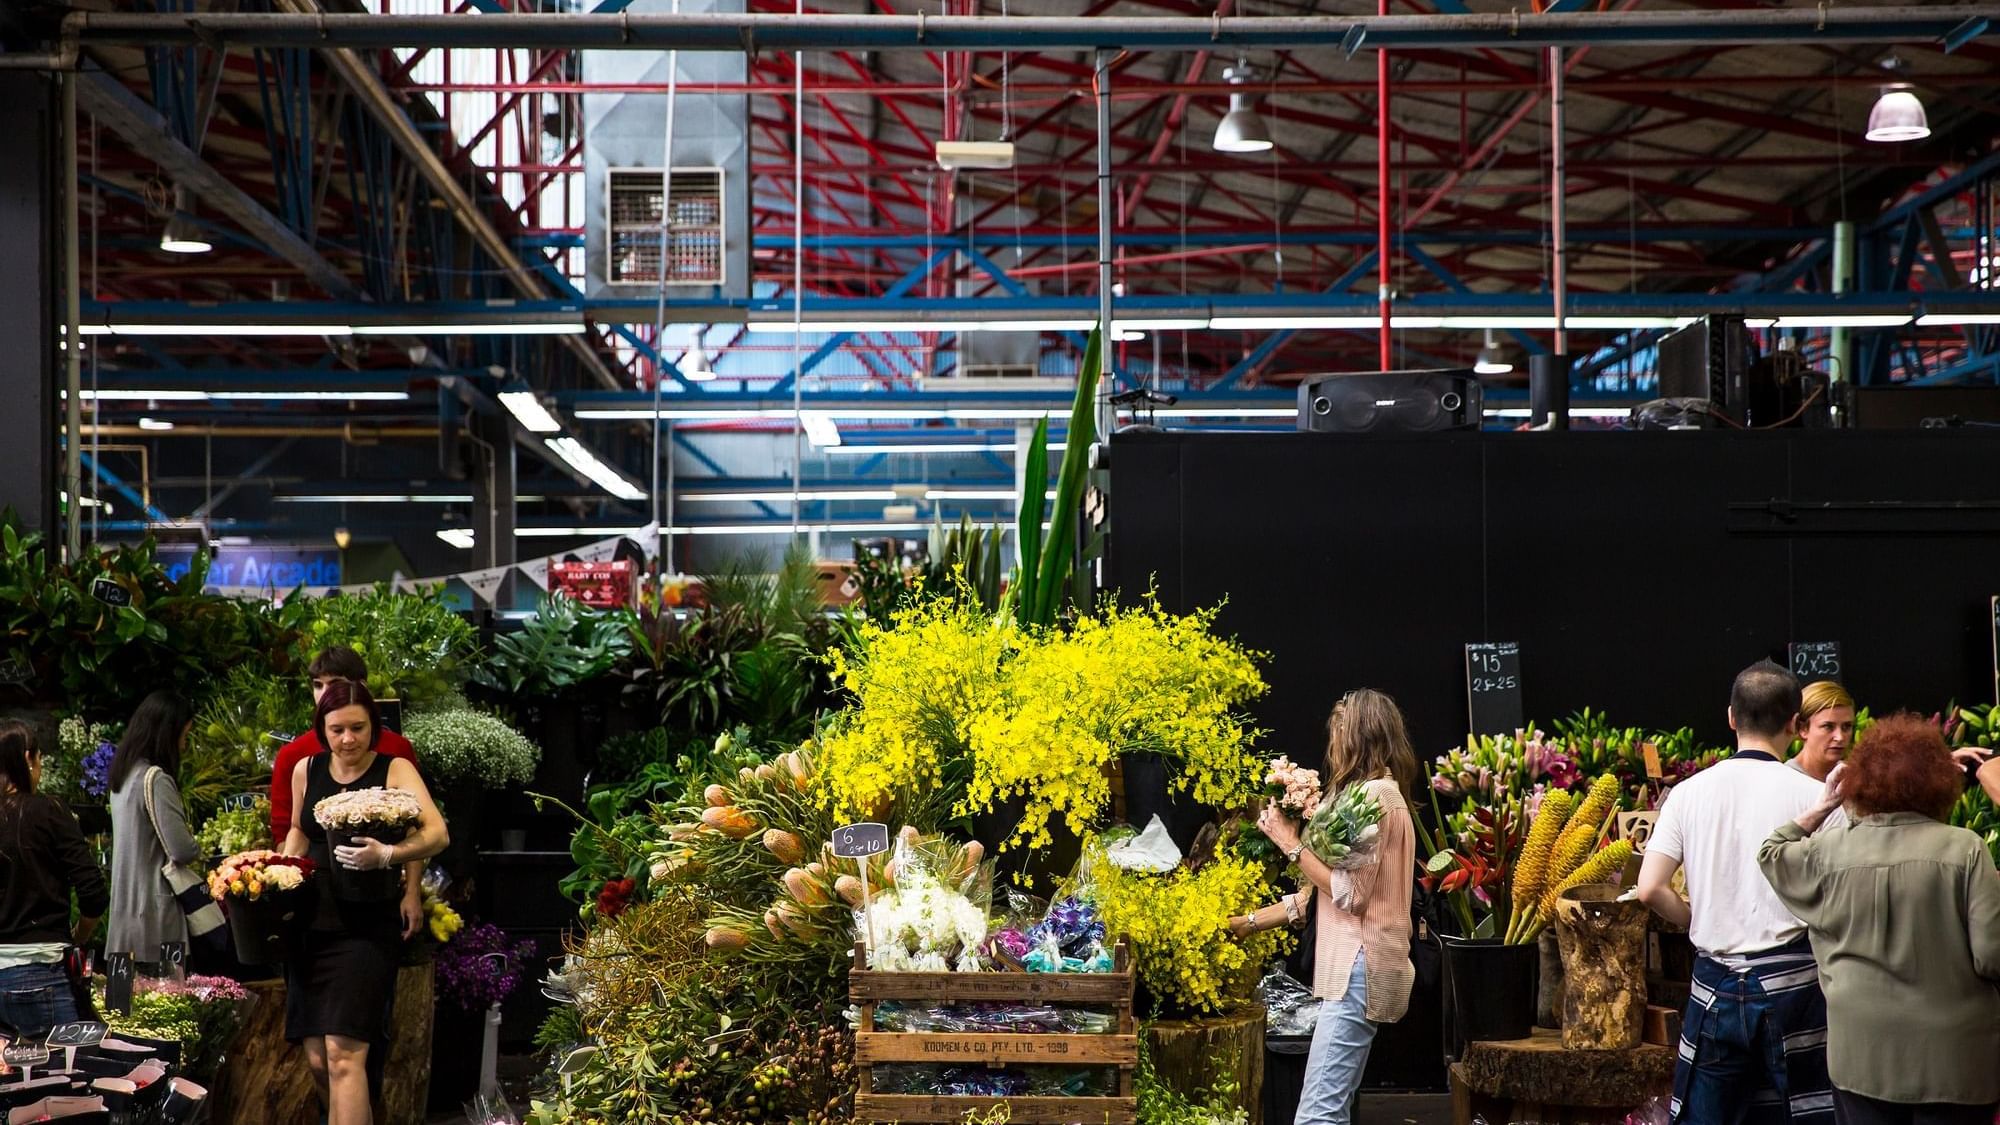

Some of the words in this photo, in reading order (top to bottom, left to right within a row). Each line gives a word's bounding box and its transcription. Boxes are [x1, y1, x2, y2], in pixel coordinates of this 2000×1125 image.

[241, 556, 340, 587] Arcade
[1472, 653, 1500, 672] $15
[843, 827, 854, 844] 6
[867, 840, 880, 852] 10
[924, 1041, 960, 1053] KOOMEN
[963, 1041, 970, 1053] &
[974, 1041, 989, 1053] CO.
[992, 1041, 1012, 1053] PTY.
[1015, 1041, 1036, 1053] LTD.
